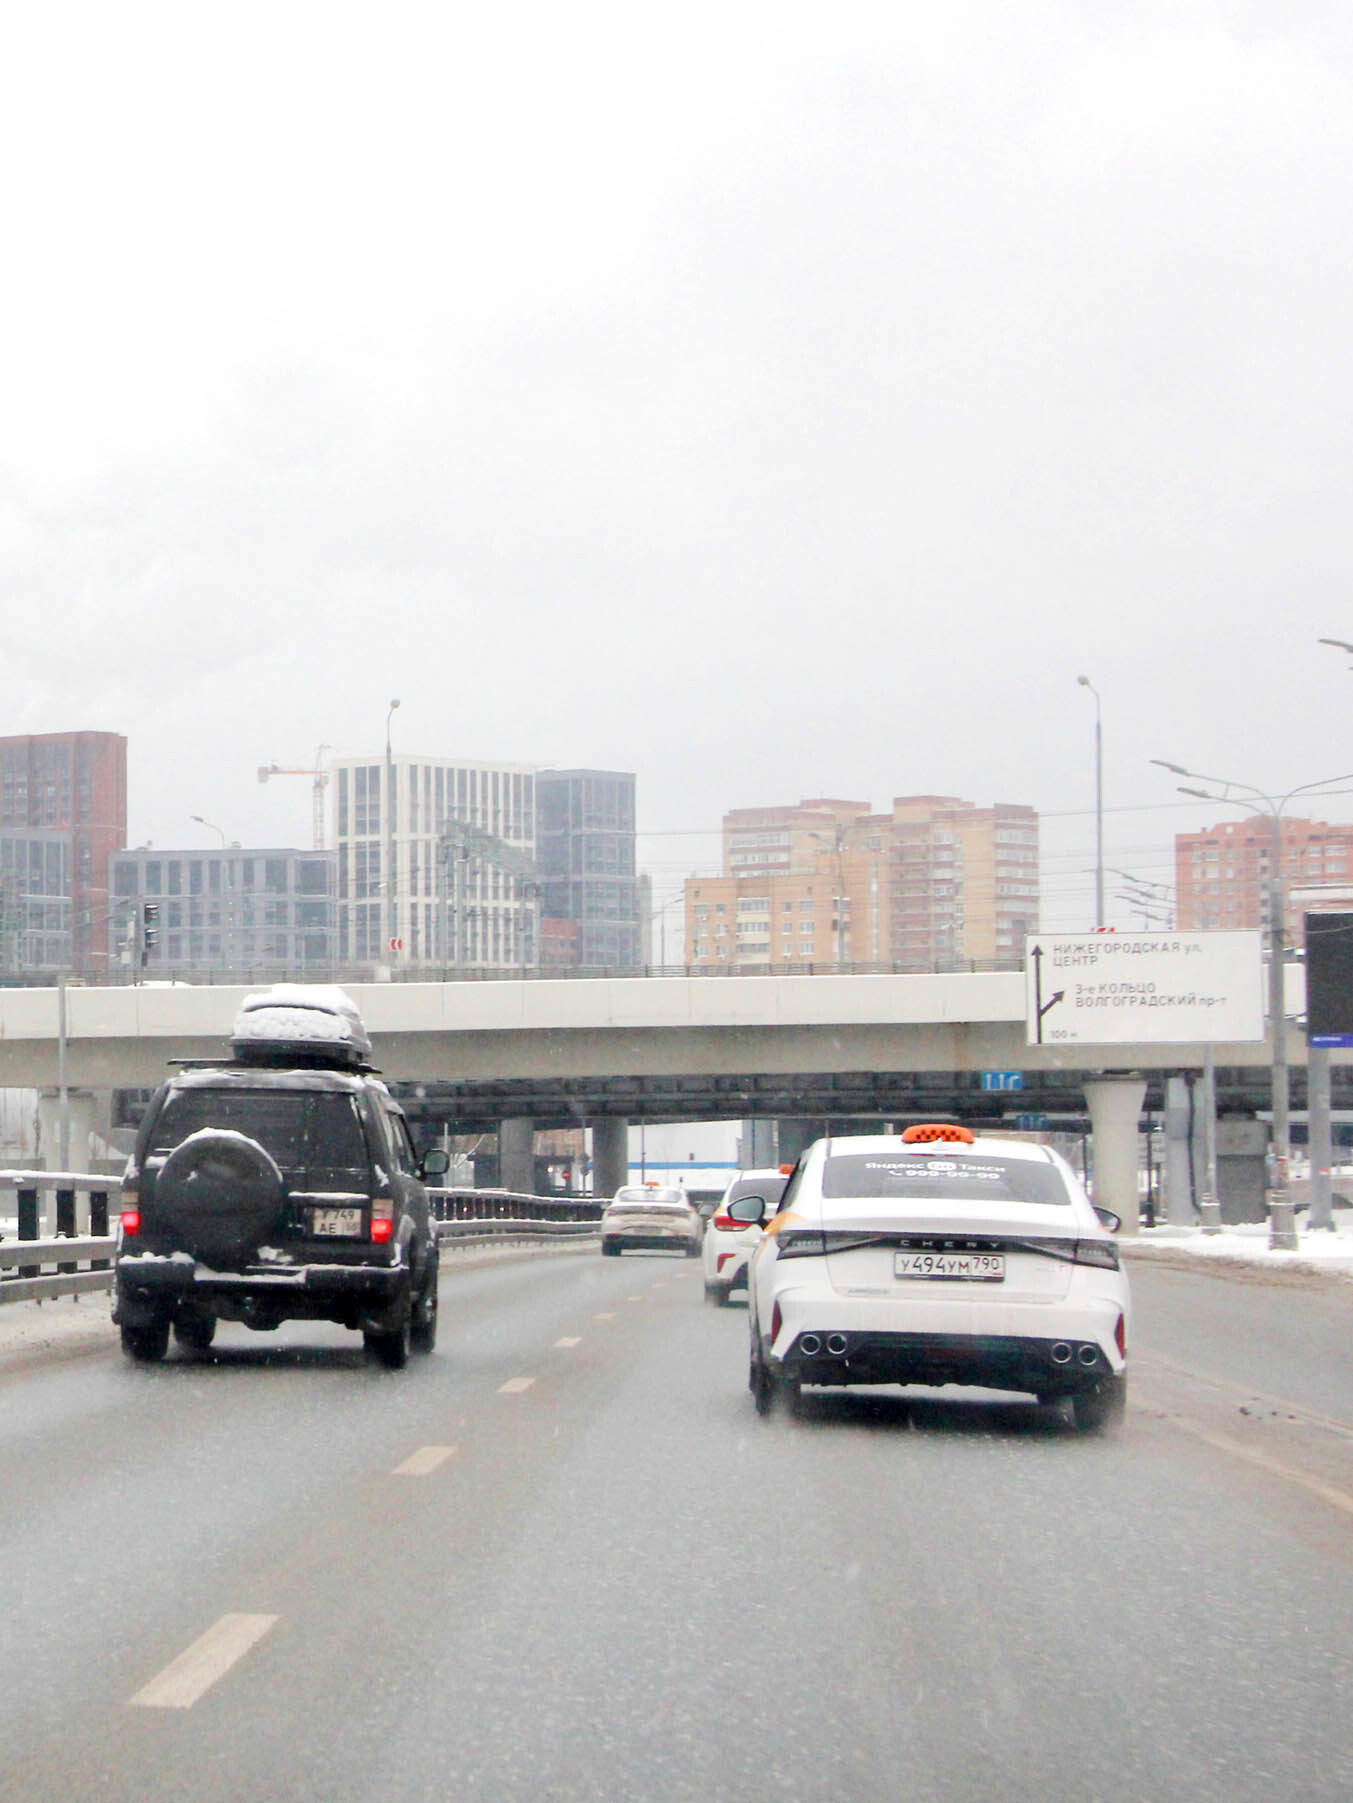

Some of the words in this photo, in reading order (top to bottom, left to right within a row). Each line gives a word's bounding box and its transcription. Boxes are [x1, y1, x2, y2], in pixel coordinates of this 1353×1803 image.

[1053, 943, 1180, 954] НИЖЕГОРОДСКАЯ
[1053, 955, 1098, 967] ЦЕНТР
[1098, 982, 1156, 995] КОЛЬЦО
[1075, 992, 1196, 1008] ВОЛГОГРАДСКИЙ
[865, 1161, 925, 1169] Яндекс
[960, 1163, 1006, 1172] Такси
[900, 1239, 1001, 1248] CHERY
